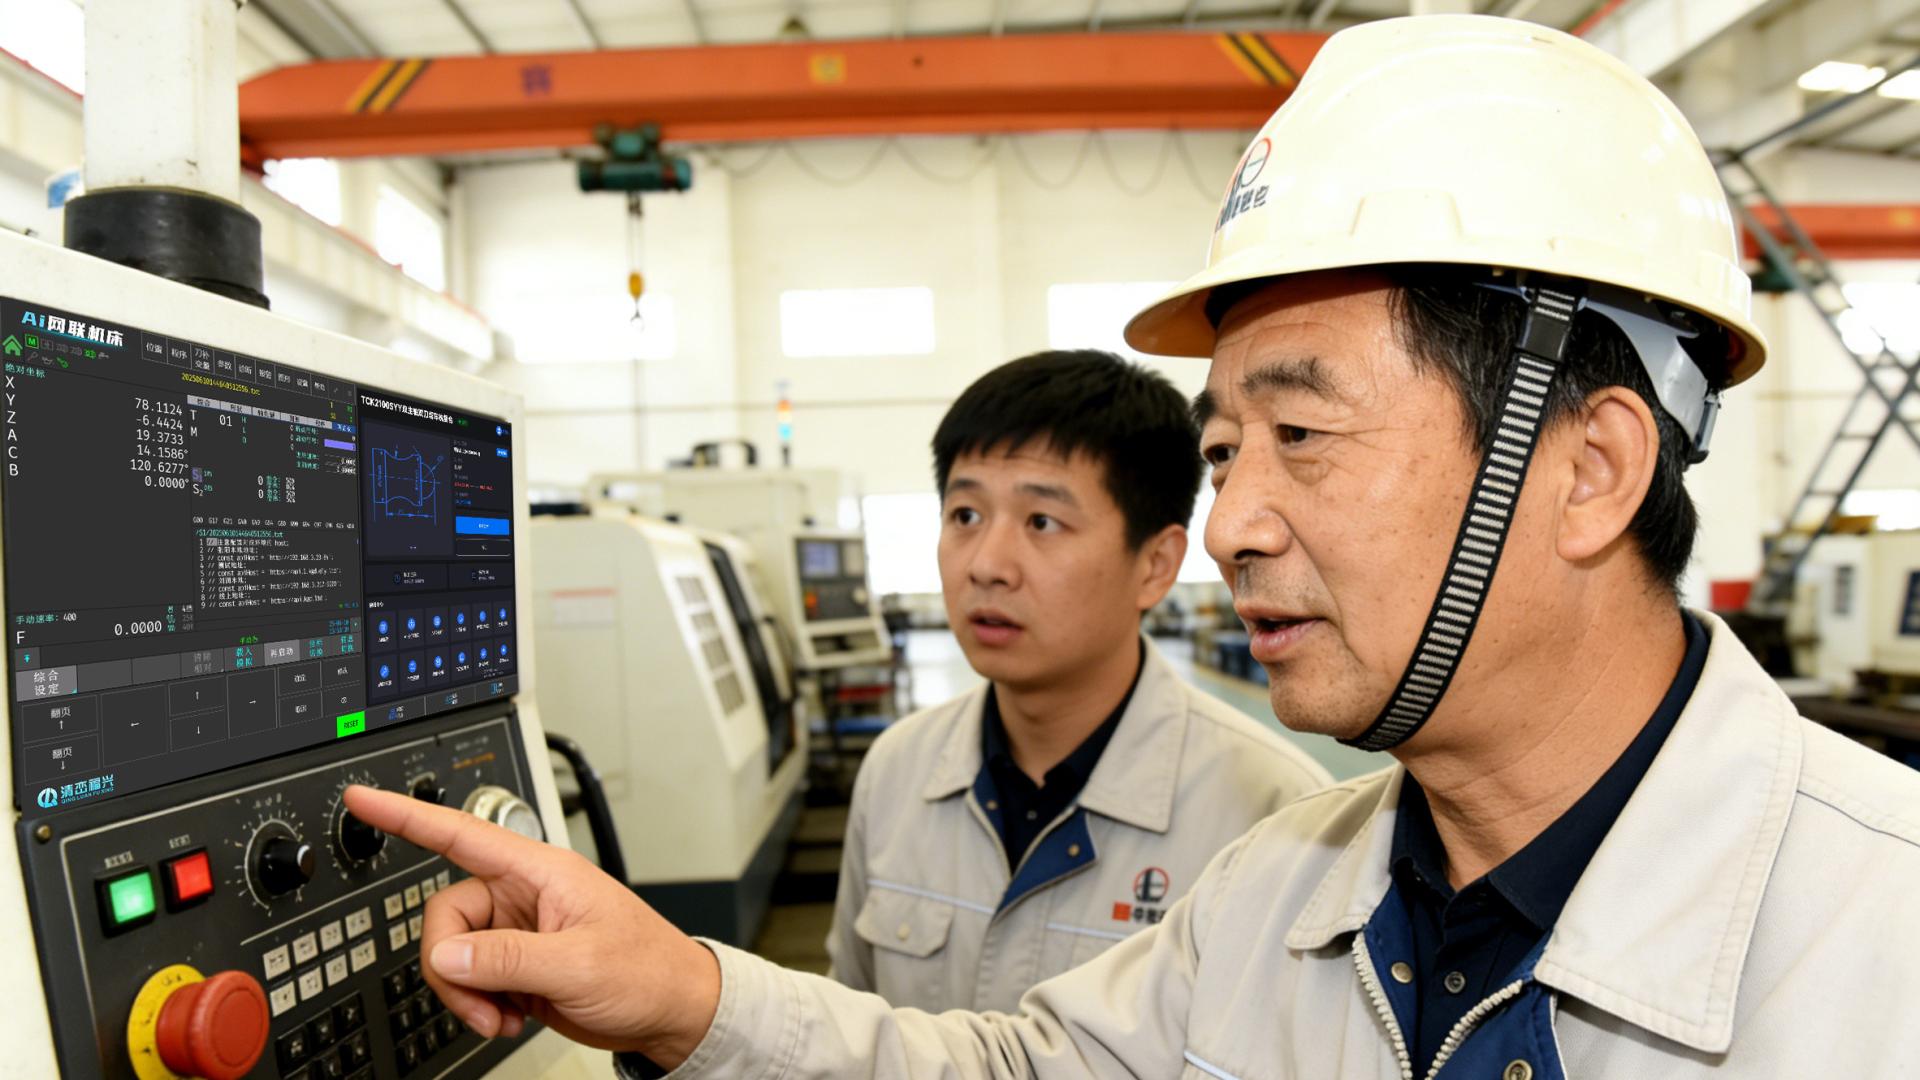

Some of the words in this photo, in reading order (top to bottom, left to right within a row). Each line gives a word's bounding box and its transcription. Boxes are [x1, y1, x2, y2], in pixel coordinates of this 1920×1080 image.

[22, 311, 124, 347] Ai网联机床
[4, 362, 46, 378] 绝对坐标
[217, 360, 233, 372] 参数
[5, 376, 15, 389] X
[135, 398, 182, 416] 78.1124
[6, 394, 16, 407] Y
[136, 414, 183, 430] -6.4424
[190, 410, 197, 421] T
[219, 415, 233, 427] 01
[7, 411, 16, 424] Z
[136, 429, 184, 445] 19.3733
[190, 426, 198, 437] M
[7, 428, 17, 442] A
[8, 446, 18, 459] C
[9, 463, 19, 476] B
[63, 612, 77, 622] 400
[17, 631, 25, 644] F
[114, 621, 162, 636] 0.0000
[33, 670, 59, 683] 综合
[34, 683, 59, 696] 设定
[51, 706, 71, 719] 翻页
[344, 719, 359, 729] RESET
[52, 747, 72, 760] 翻页
